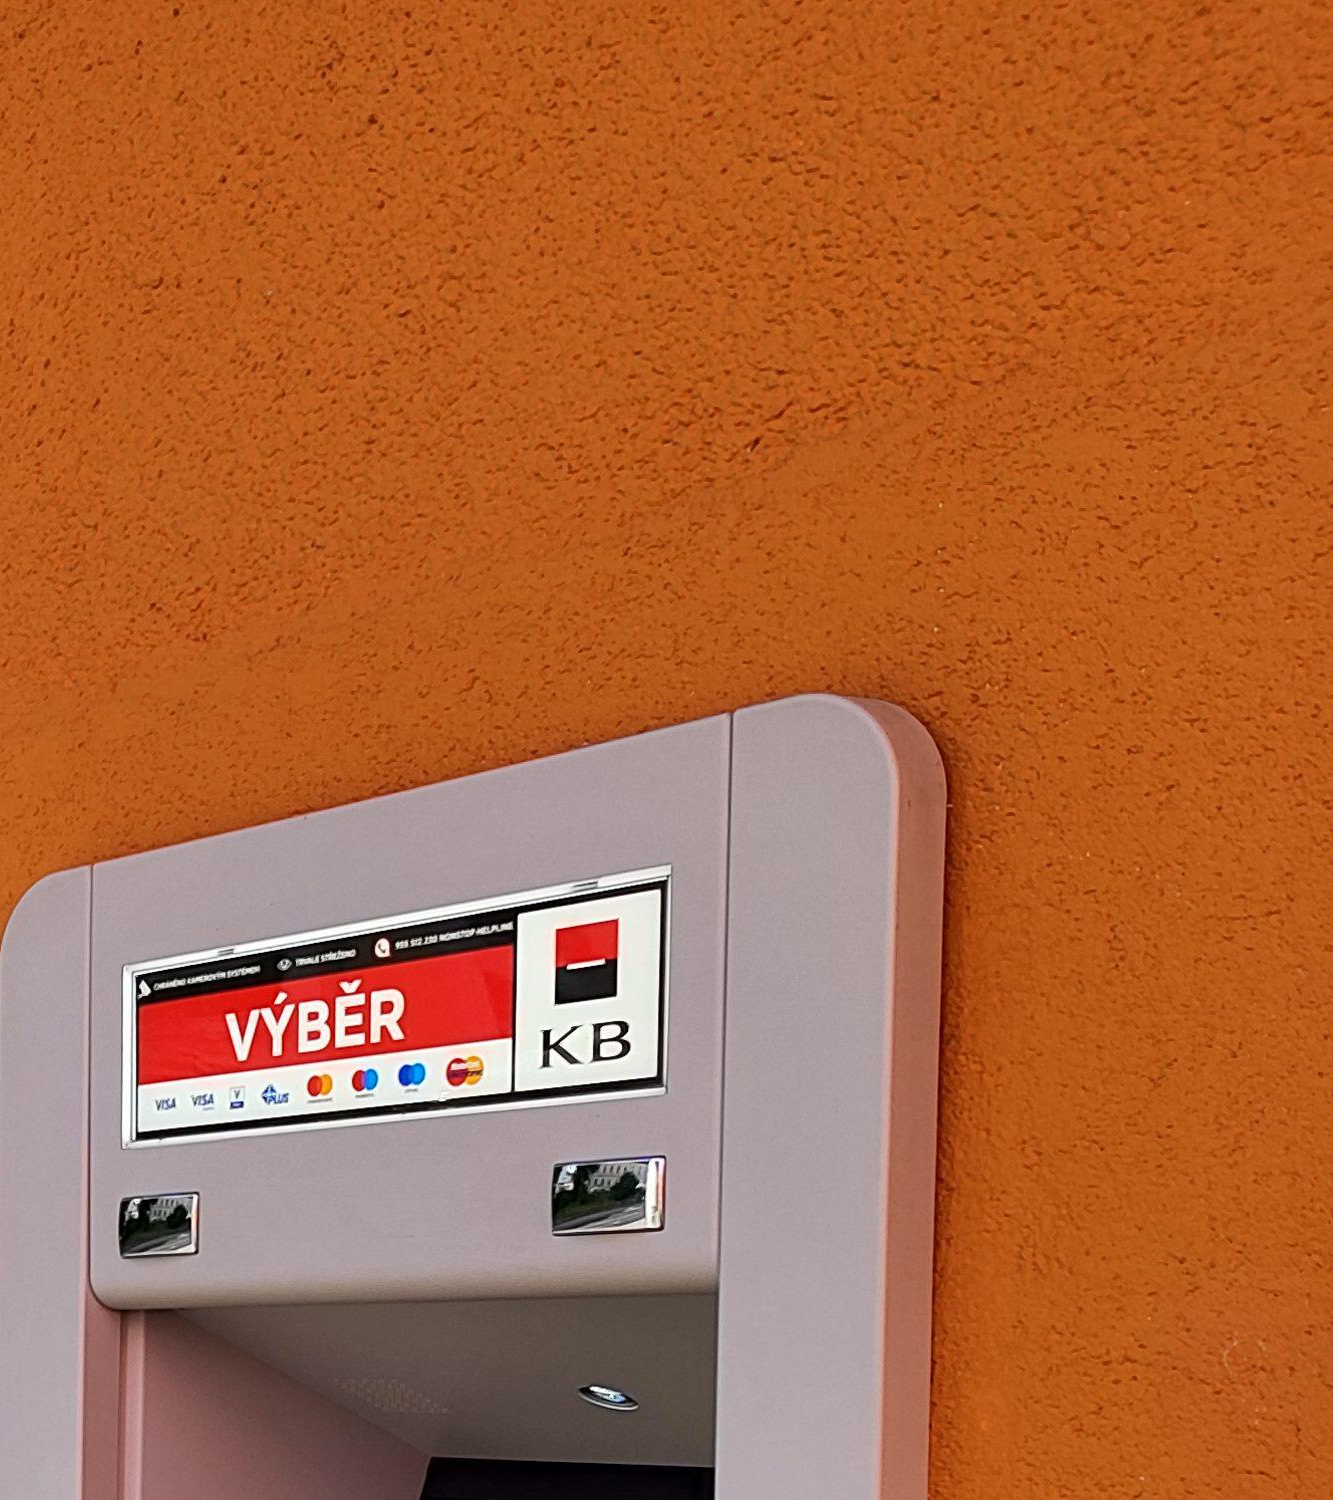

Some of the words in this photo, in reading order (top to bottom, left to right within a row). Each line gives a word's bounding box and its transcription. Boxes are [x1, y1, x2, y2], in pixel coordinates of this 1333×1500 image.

[225, 979, 405, 1062] VÝBĚR
[539, 1020, 631, 1069] KB
[155, 1097, 177, 1111] VISA
[191, 1093, 215, 1107] VISA
